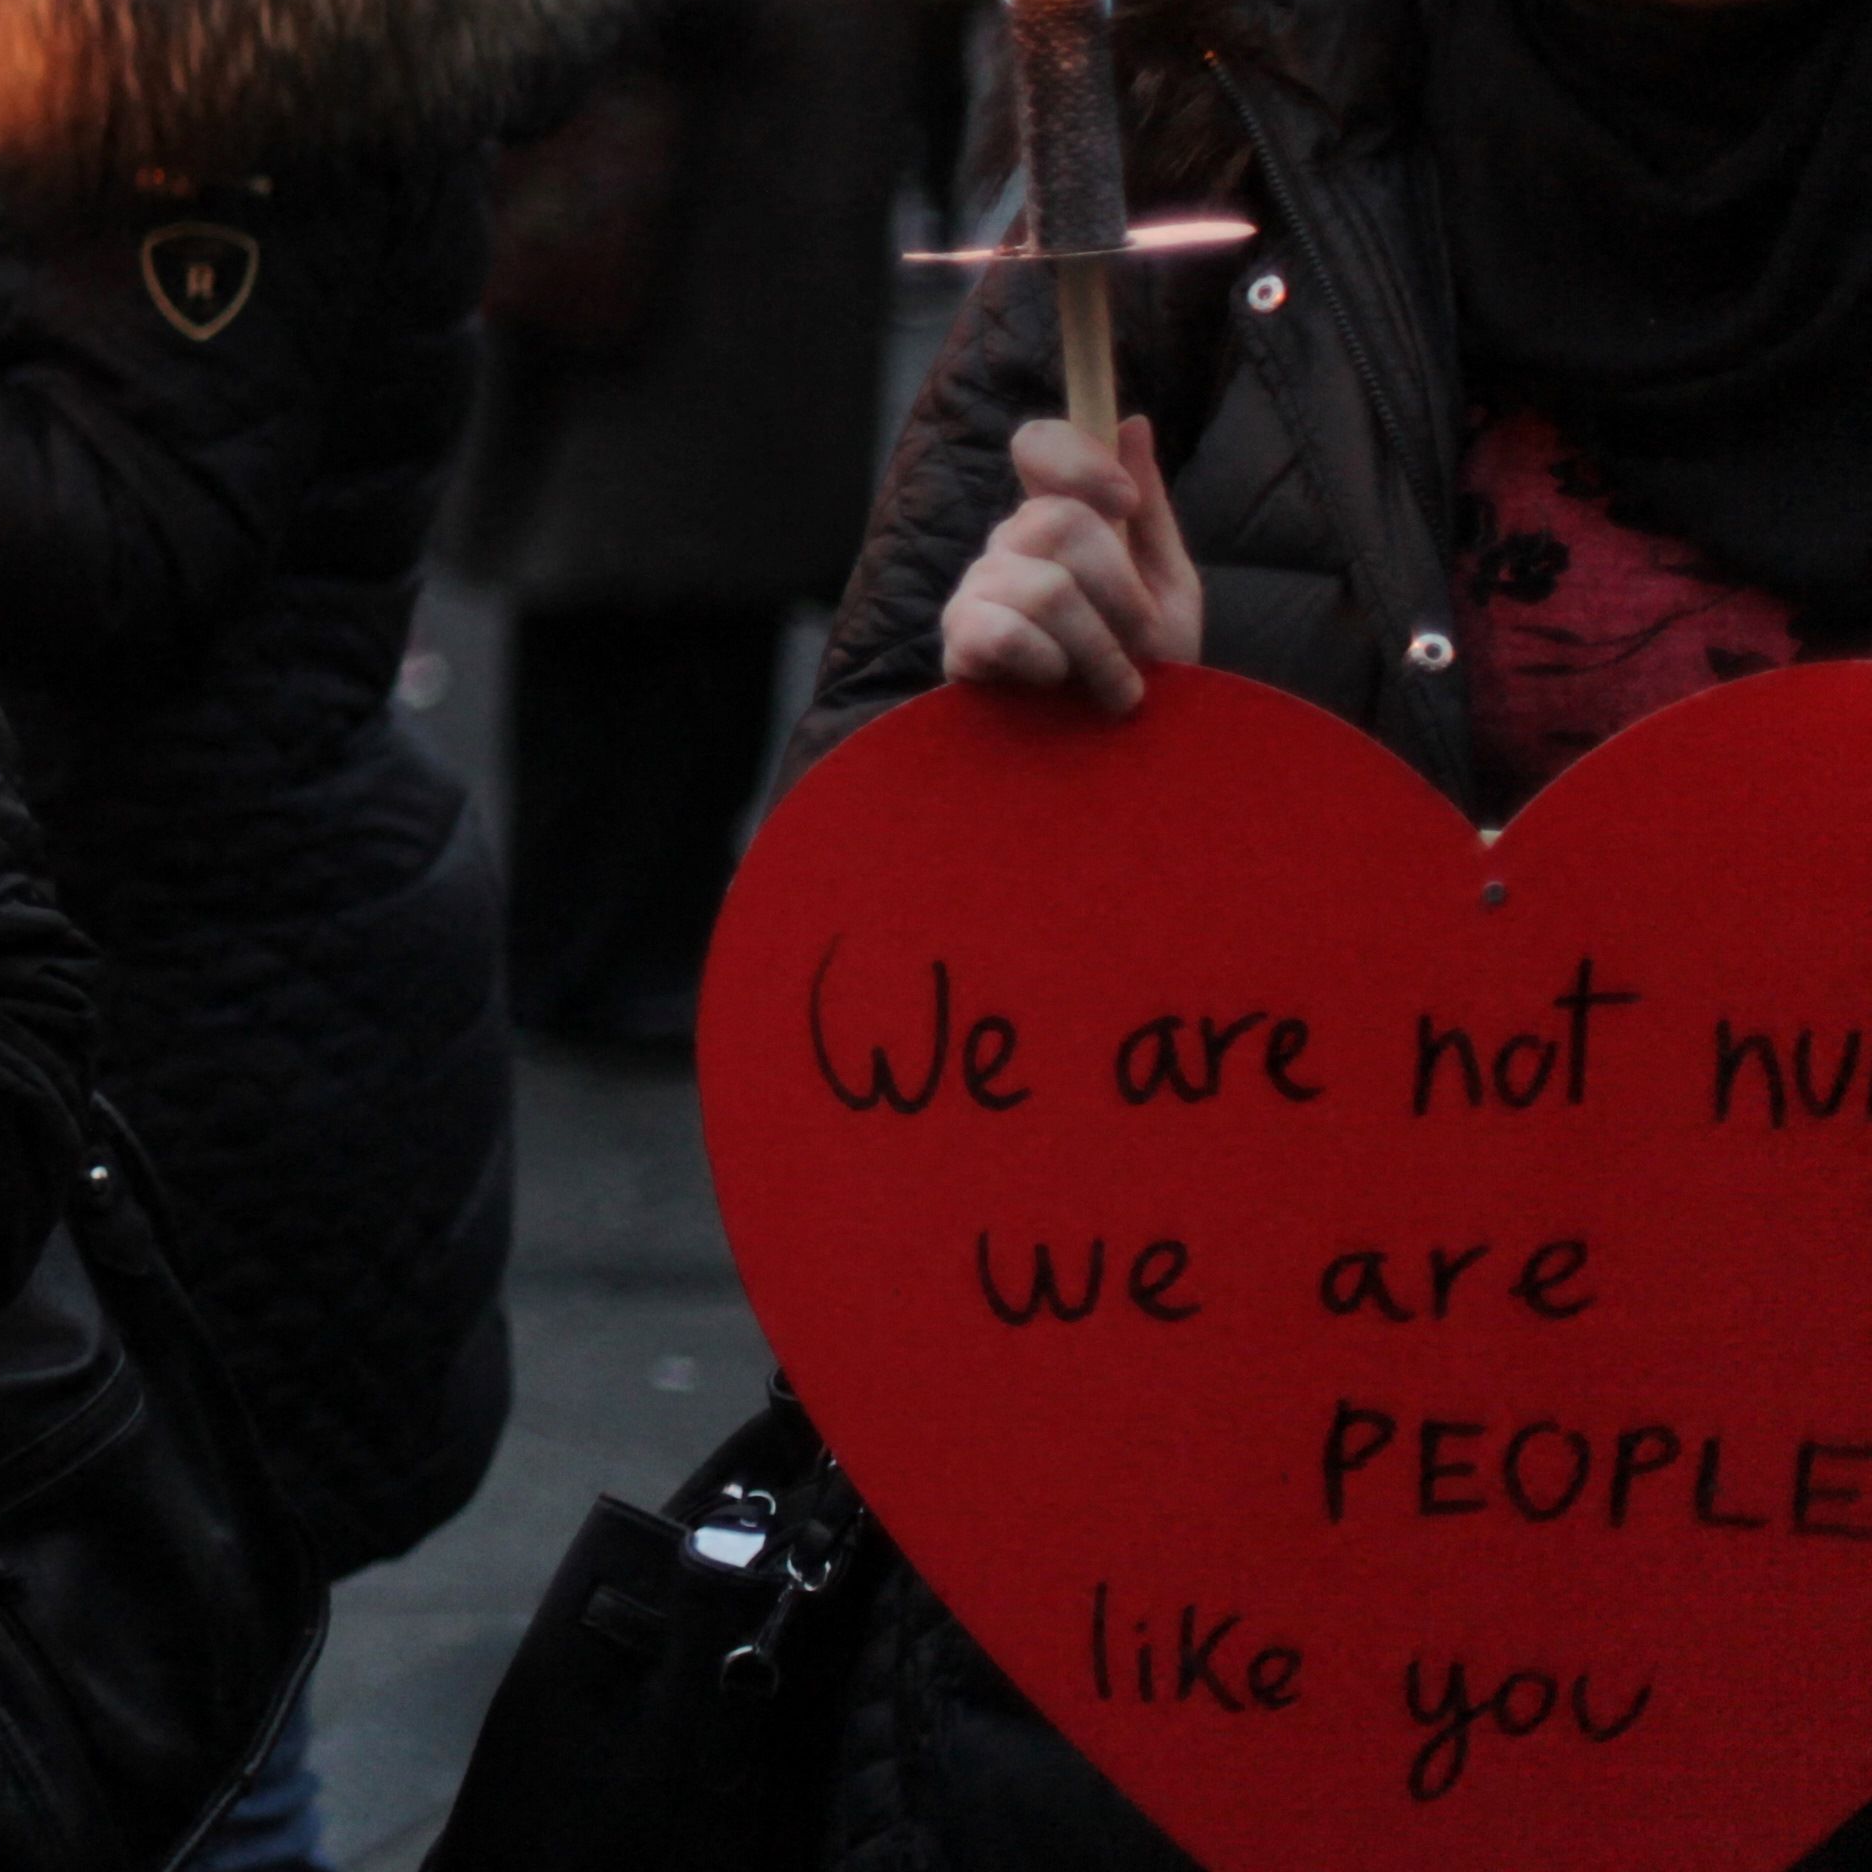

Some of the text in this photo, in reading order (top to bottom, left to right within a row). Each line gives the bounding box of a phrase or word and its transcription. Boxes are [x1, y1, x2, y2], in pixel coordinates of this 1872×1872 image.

[809, 932, 1872, 1130] We are not nu
[976, 1230, 1595, 1327] we are
[1320, 1398, 1872, 1542] PEOPLE
[1403, 1652, 1655, 1804] you
